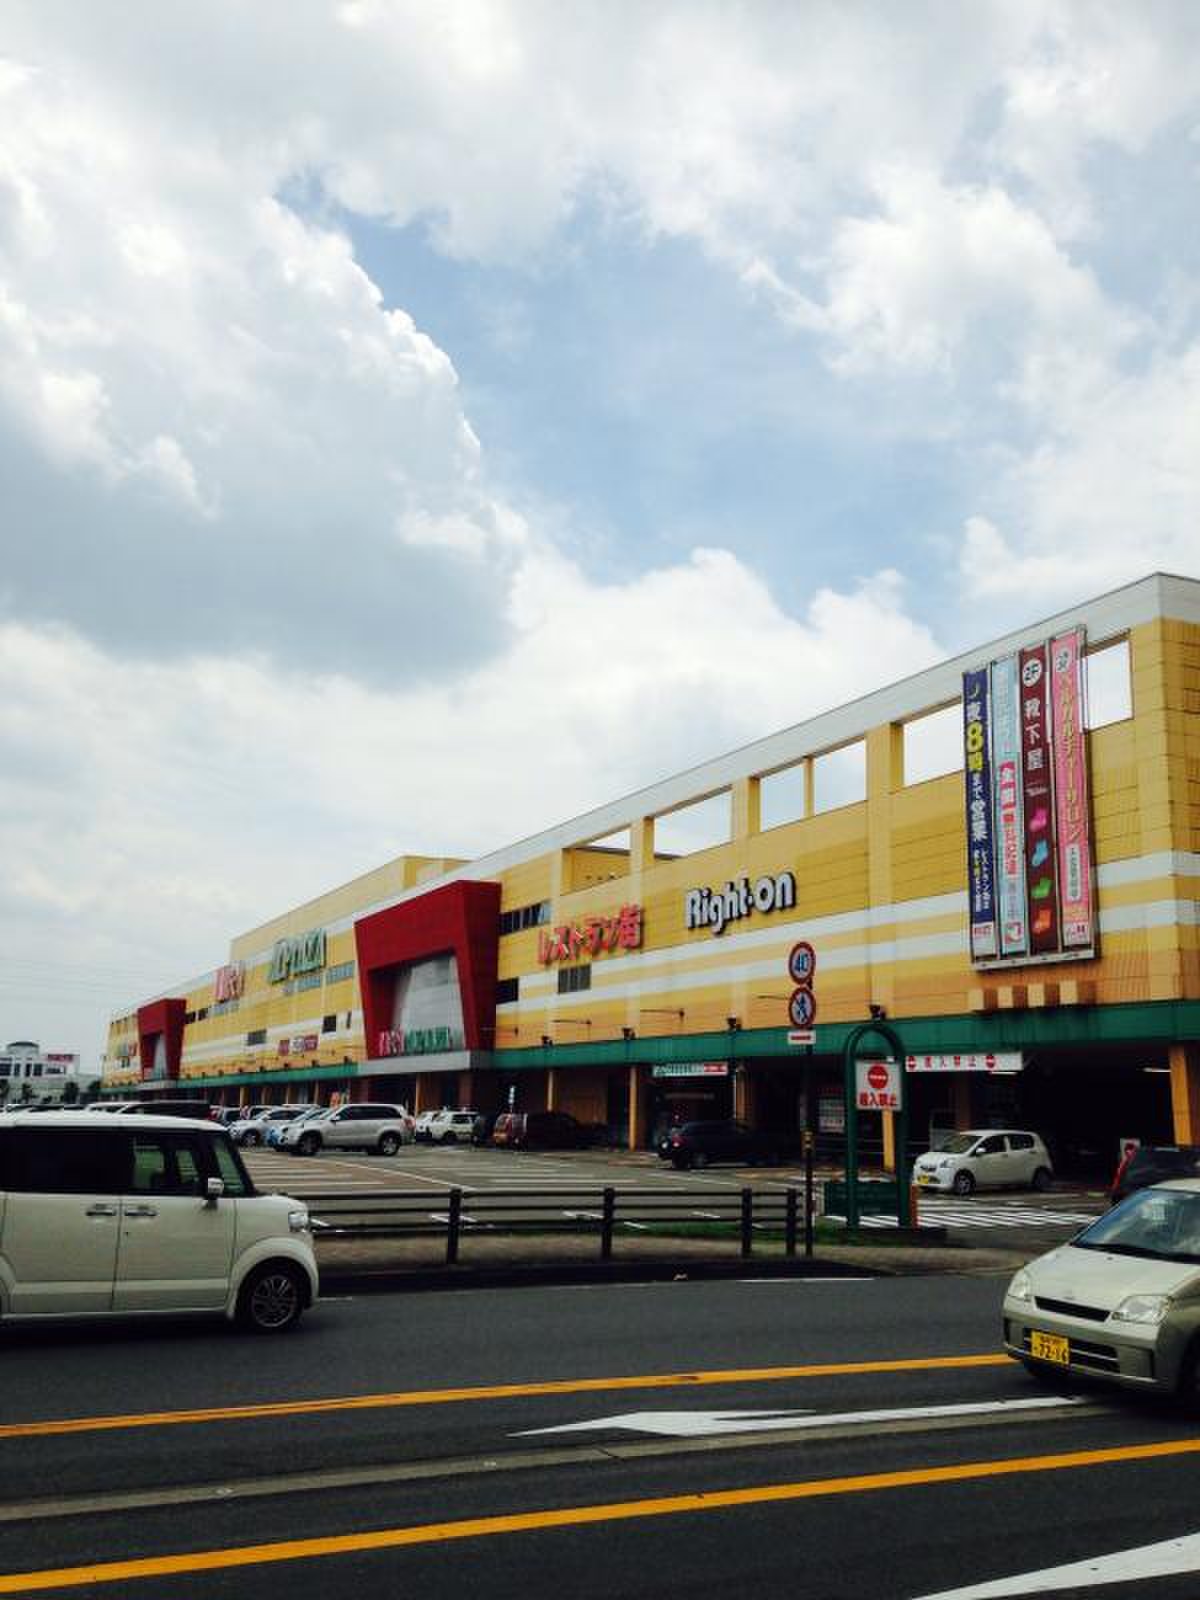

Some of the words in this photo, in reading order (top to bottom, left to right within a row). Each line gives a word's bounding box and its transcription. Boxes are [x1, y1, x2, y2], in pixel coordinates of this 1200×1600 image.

[538, 902, 643, 965] レストラン街
[794, 952, 809, 973] 40
